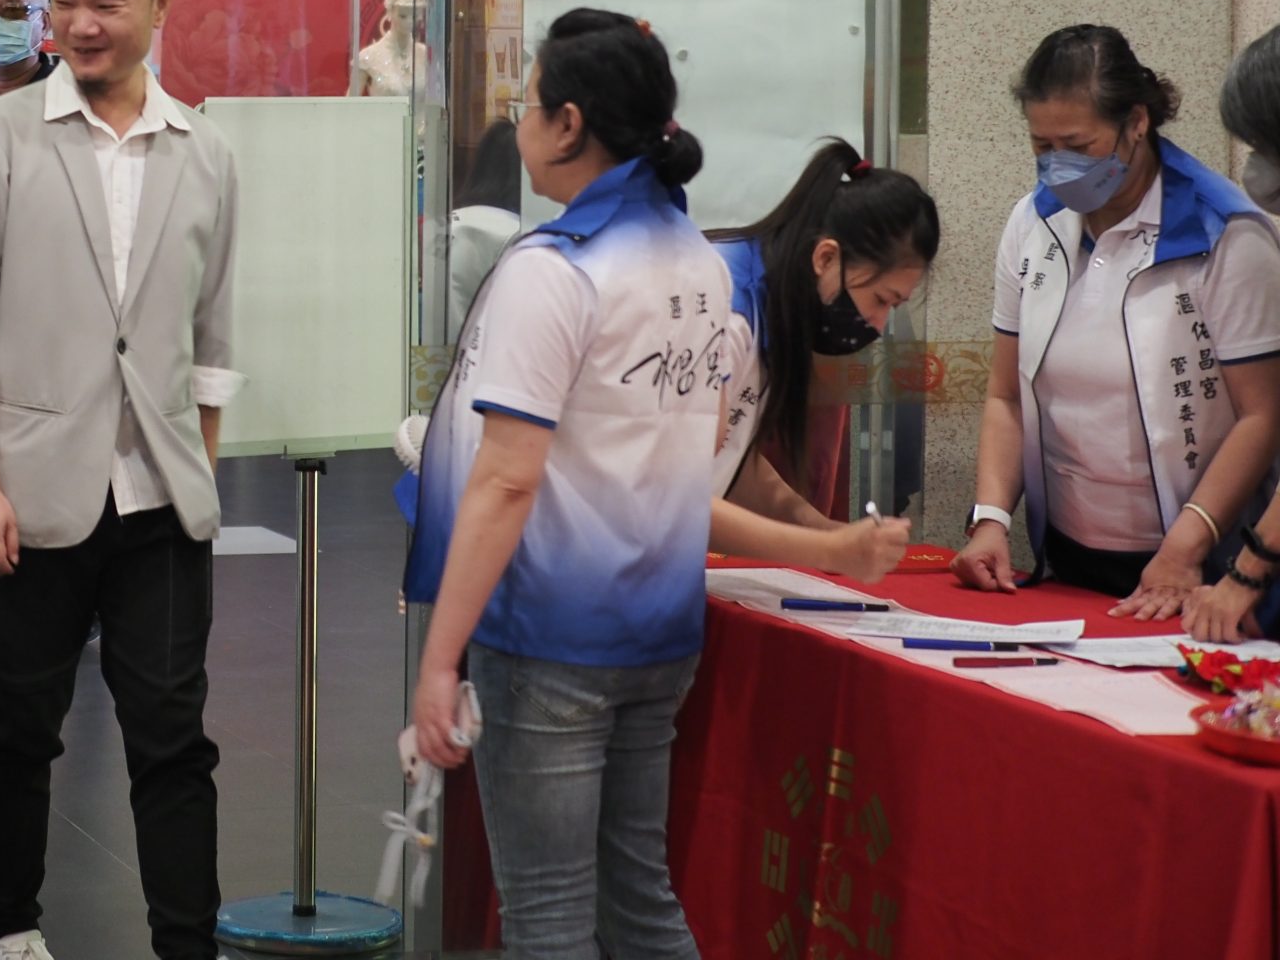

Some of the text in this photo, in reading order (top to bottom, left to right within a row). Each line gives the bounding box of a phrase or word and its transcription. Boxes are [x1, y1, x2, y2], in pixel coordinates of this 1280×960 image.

[1170, 355, 1199, 470] 管理委員會
